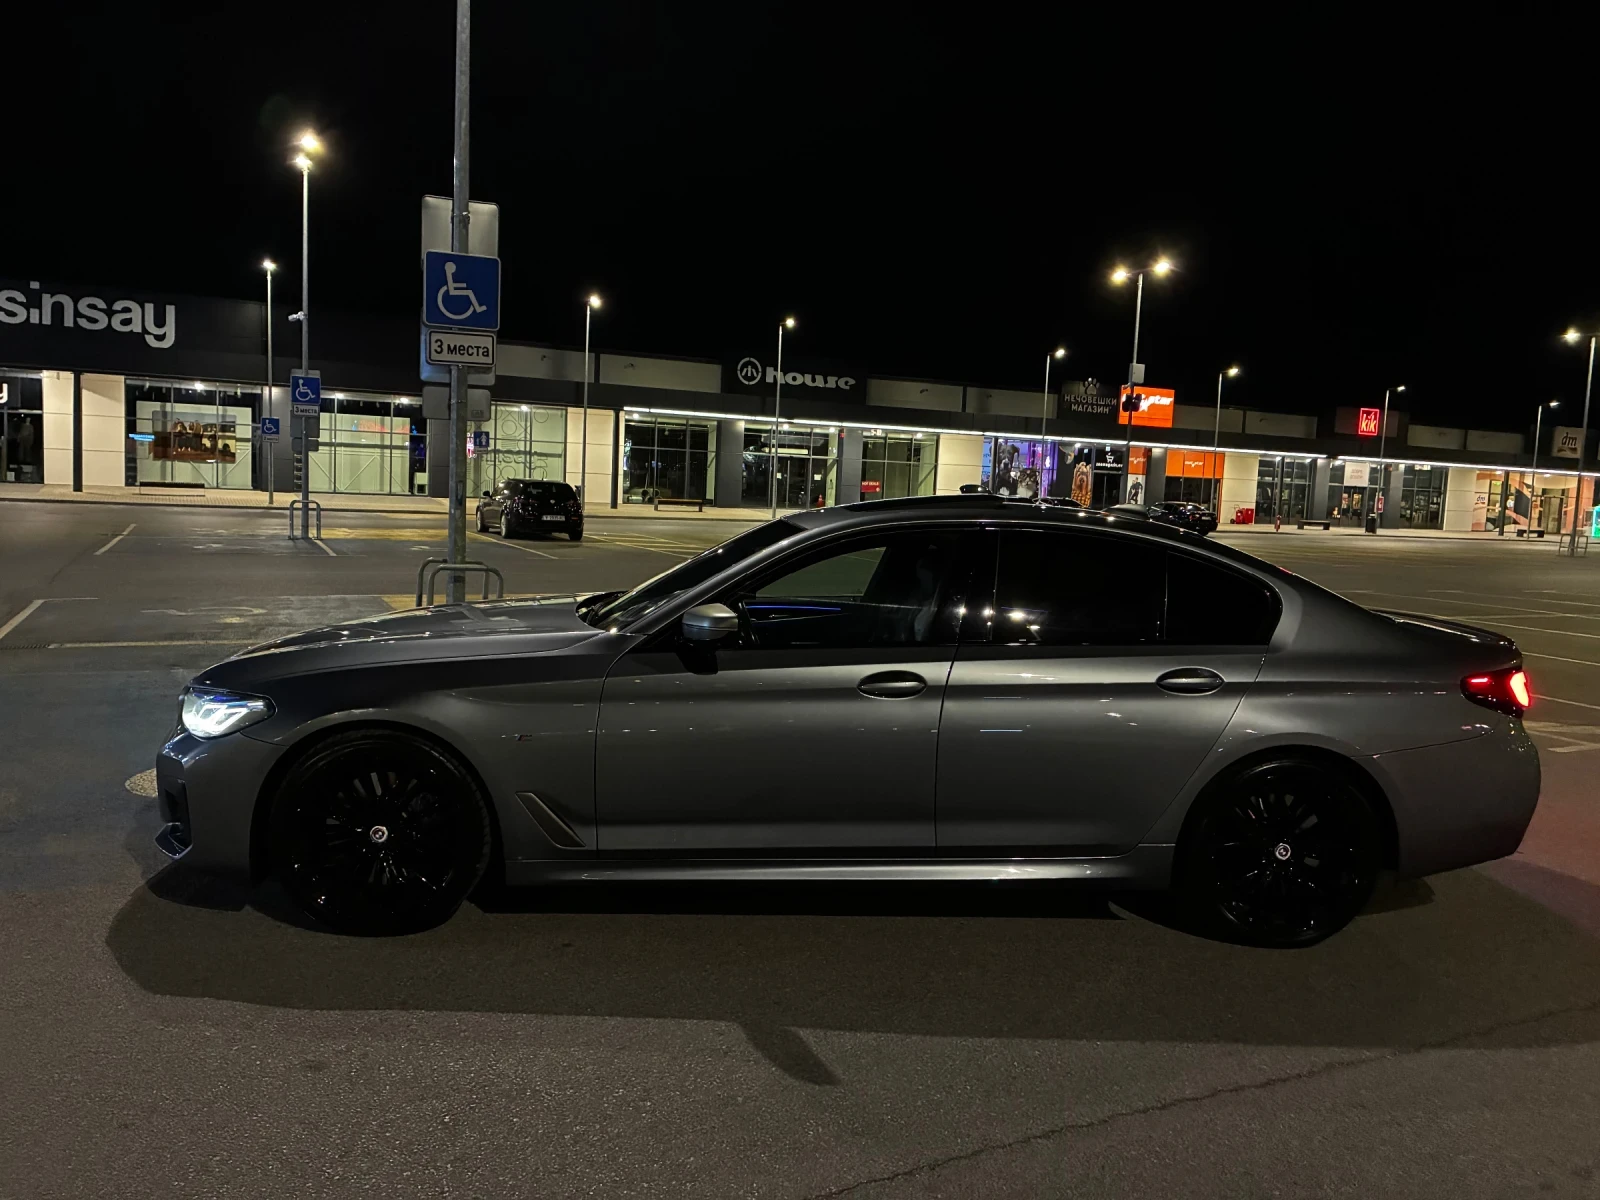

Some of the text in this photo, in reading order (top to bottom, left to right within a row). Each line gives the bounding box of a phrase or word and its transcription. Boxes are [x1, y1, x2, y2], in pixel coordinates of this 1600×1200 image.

[0, 281, 175, 348] sinsay
[434, 338, 489, 357] 3 места
[765, 366, 856, 389] house
[1064, 393, 1117, 406] НЕЧОВЕШКИ
[1071, 403, 1110, 415] МАГАЗИН
[1561, 431, 1578, 447] dm
